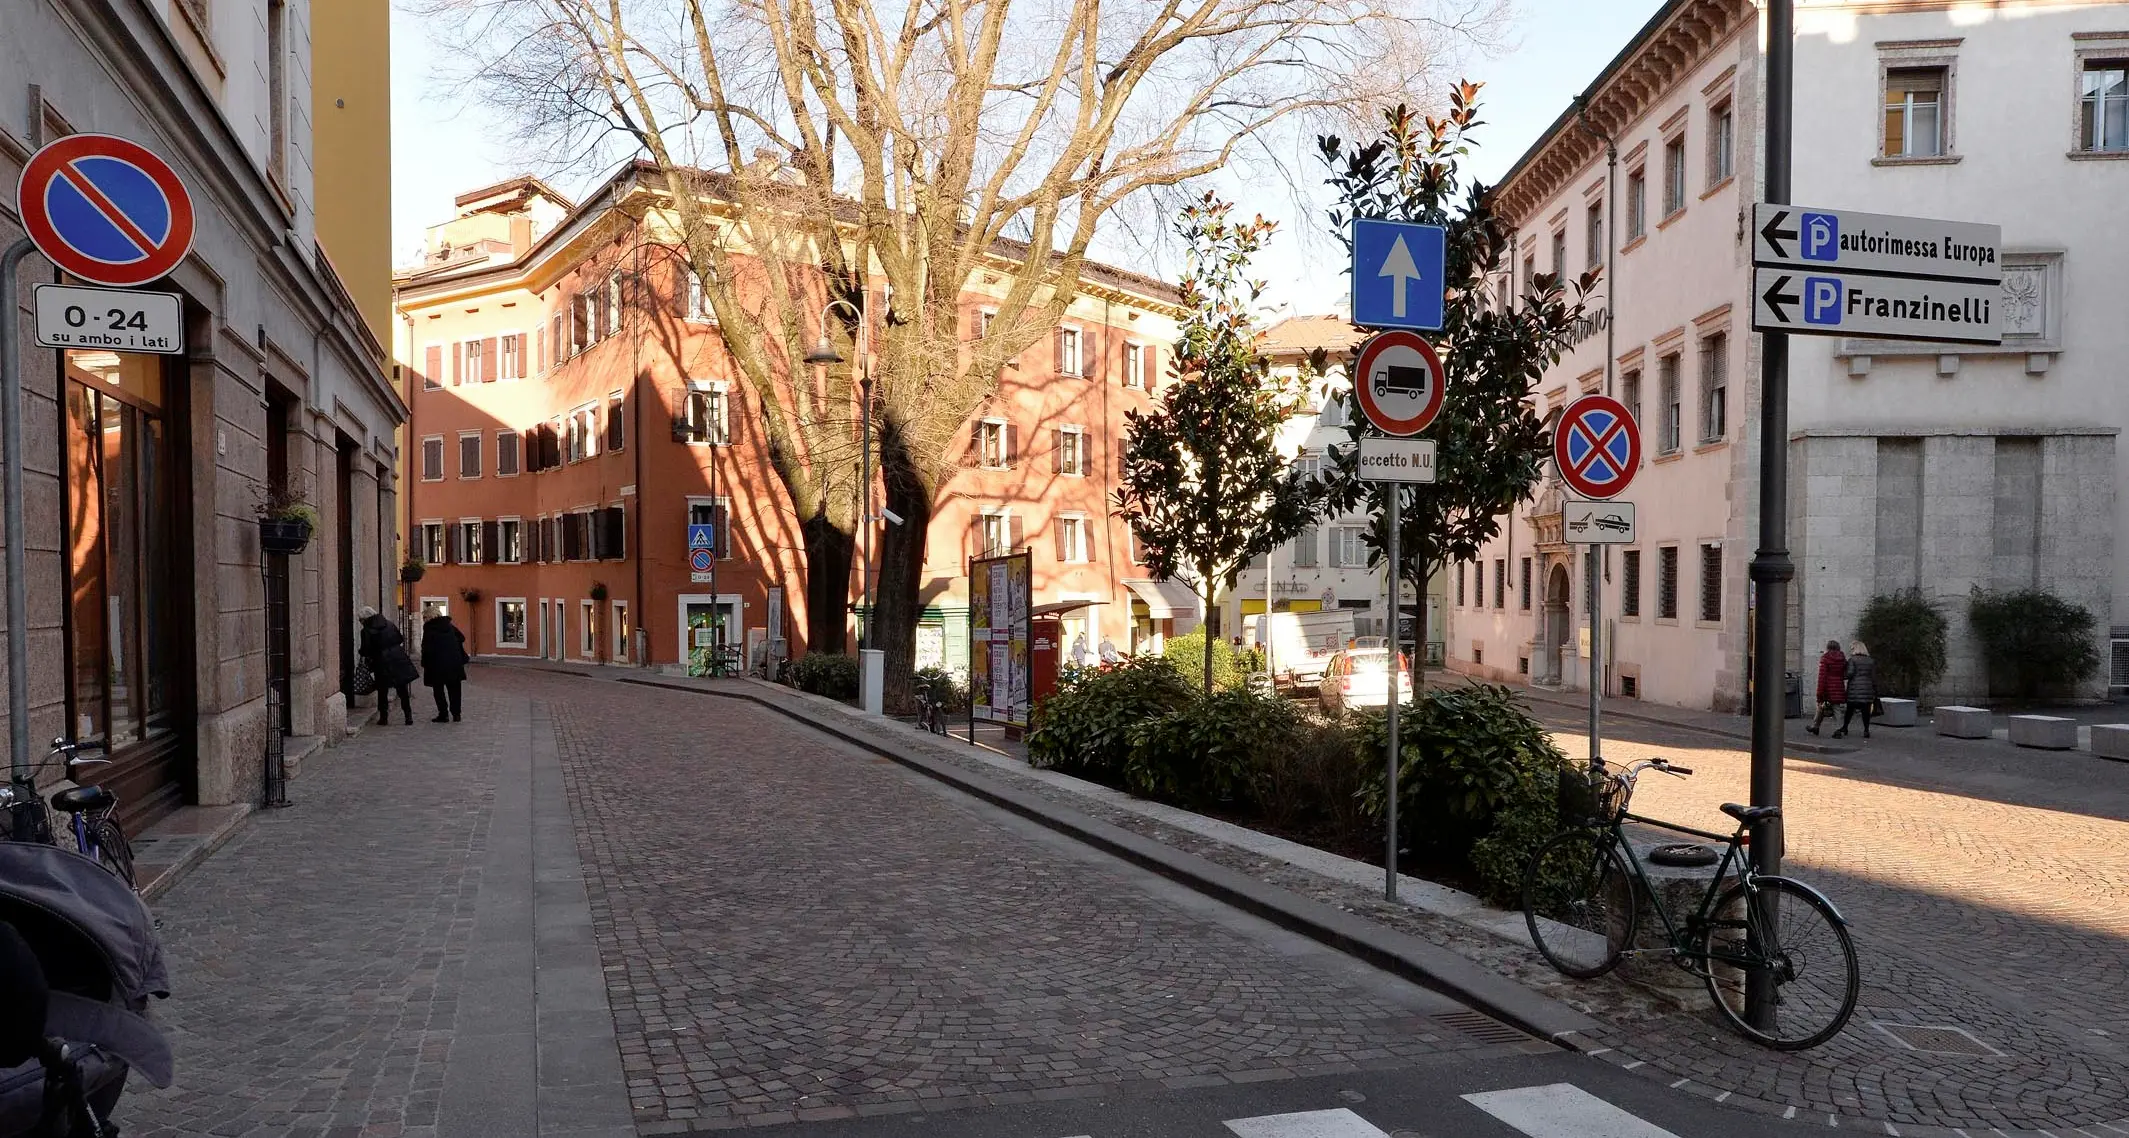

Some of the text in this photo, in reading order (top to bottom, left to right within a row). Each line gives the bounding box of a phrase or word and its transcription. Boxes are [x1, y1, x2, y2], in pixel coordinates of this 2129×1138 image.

[1839, 229, 1938, 259] autorimessa
[1944, 237, 1995, 266] Europa
[1847, 288, 1990, 324] Franzinelli
[52, 331, 169, 348] su ambo i lati
[1361, 452, 1433, 469] eccetto N.U.
